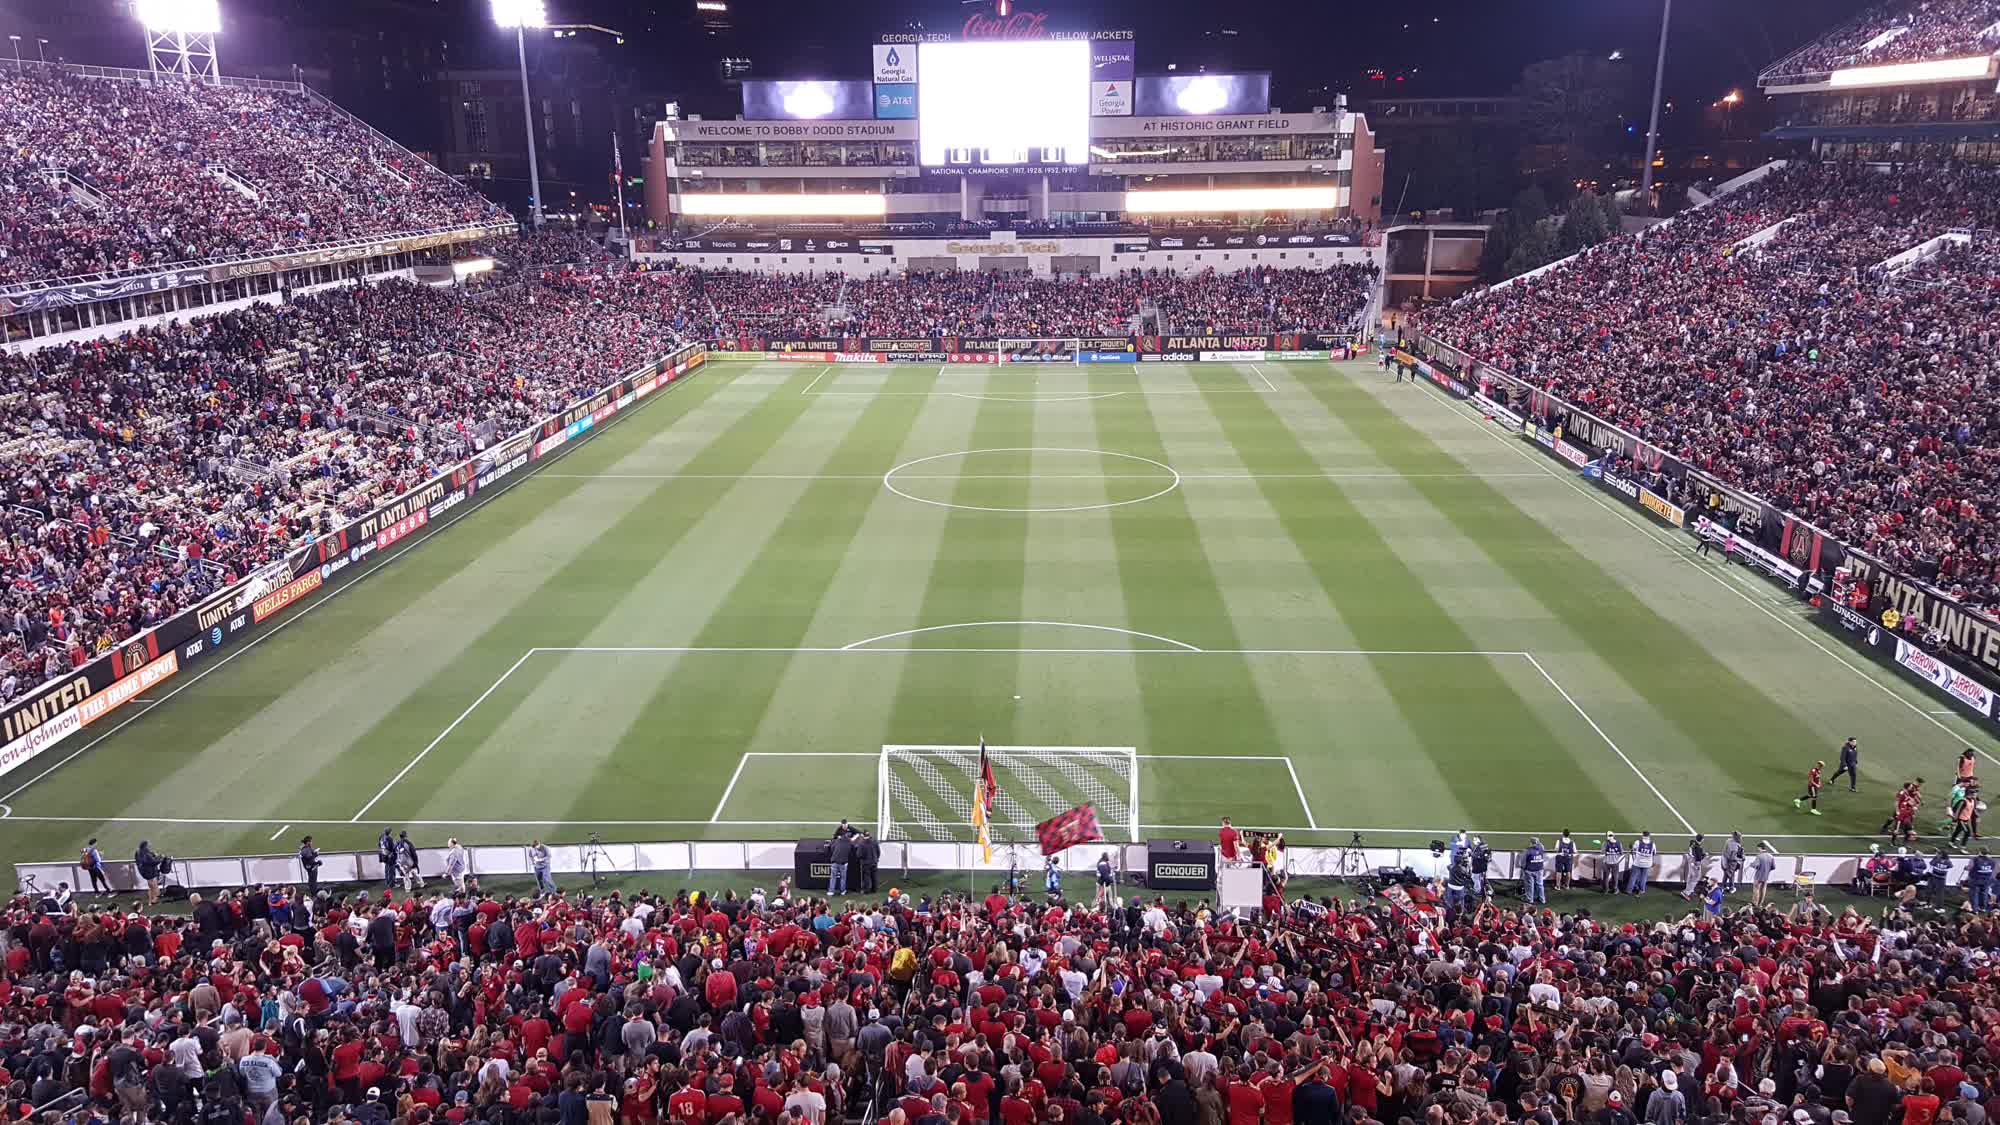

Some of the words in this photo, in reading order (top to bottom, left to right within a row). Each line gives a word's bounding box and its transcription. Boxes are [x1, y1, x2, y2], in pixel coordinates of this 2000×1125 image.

[882, 33, 923, 43] GEORGIA
[927, 33, 951, 42] TECH
[1050, 31, 1088, 41] YELLOW
[1090, 31, 1133, 40] JACKETS
[876, 75, 899, 83] Natural
[881, 68, 906, 77] Georgia
[892, 96, 912, 105] AT&T
[1099, 100, 1125, 109] Georgia
[698, 127, 752, 136] WELCOME
[756, 126, 770, 135] TO
[773, 126, 808, 136] BOBBY
[813, 126, 844, 136] DODD
[847, 126, 895, 136] STADIUM
[1143, 122, 1156, 131] AT
[1161, 121, 1214, 131] HISTORIC
[1216, 120, 1255, 130] GRANT
[1258, 119, 1289, 129] FIELD
[947, 242, 1015, 255] Georgia
[1019, 242, 1061, 254] Tech
[808, 341, 837, 350] UNITED
[1001, 341, 1031, 349] UNITED
[1095, 340, 1125, 348] CONQUER
[1168, 337, 1220, 349] ATLANTA
[1223, 336, 1268, 348] UNITED
[1162, 353, 1193, 361] adidas
[1591, 421, 1625, 457] UNITED
[1557, 441, 1586, 466] ADVOCARE
[479, 468, 495, 488] MAJOR
[495, 461, 512, 480] LEAGUE
[1616, 478, 1637, 498] adidas
[444, 490, 466, 510] adidas
[1639, 488, 1673, 518] QUIKRETE
[361, 506, 406, 540] ATLANTA
[409, 482, 445, 514] UNITED
[254, 589, 289, 618] WELLS
[290, 570, 321, 598] FARGO
[201, 601, 234, 630] UNITE
[1832, 603, 1866, 629] LUNAZUL
[230, 614, 246, 633] AT&T
[1930, 600, 2000, 670] UNITE
[186, 639, 203, 659] AT&T
[1910, 649, 1936, 673] ARROW
[79, 694, 106, 721] THE
[107, 677, 140, 706] HOME
[140, 655, 175, 687] DEPOT
[1952, 676, 1984, 699] ARROW
[3, 675, 91, 741] UNITED
[813, 866, 830, 874] UNI
[1158, 866, 1205, 876] CONQUER
[679, 1102, 694, 1116] 18
[1922, 1108, 1930, 1121] 3
